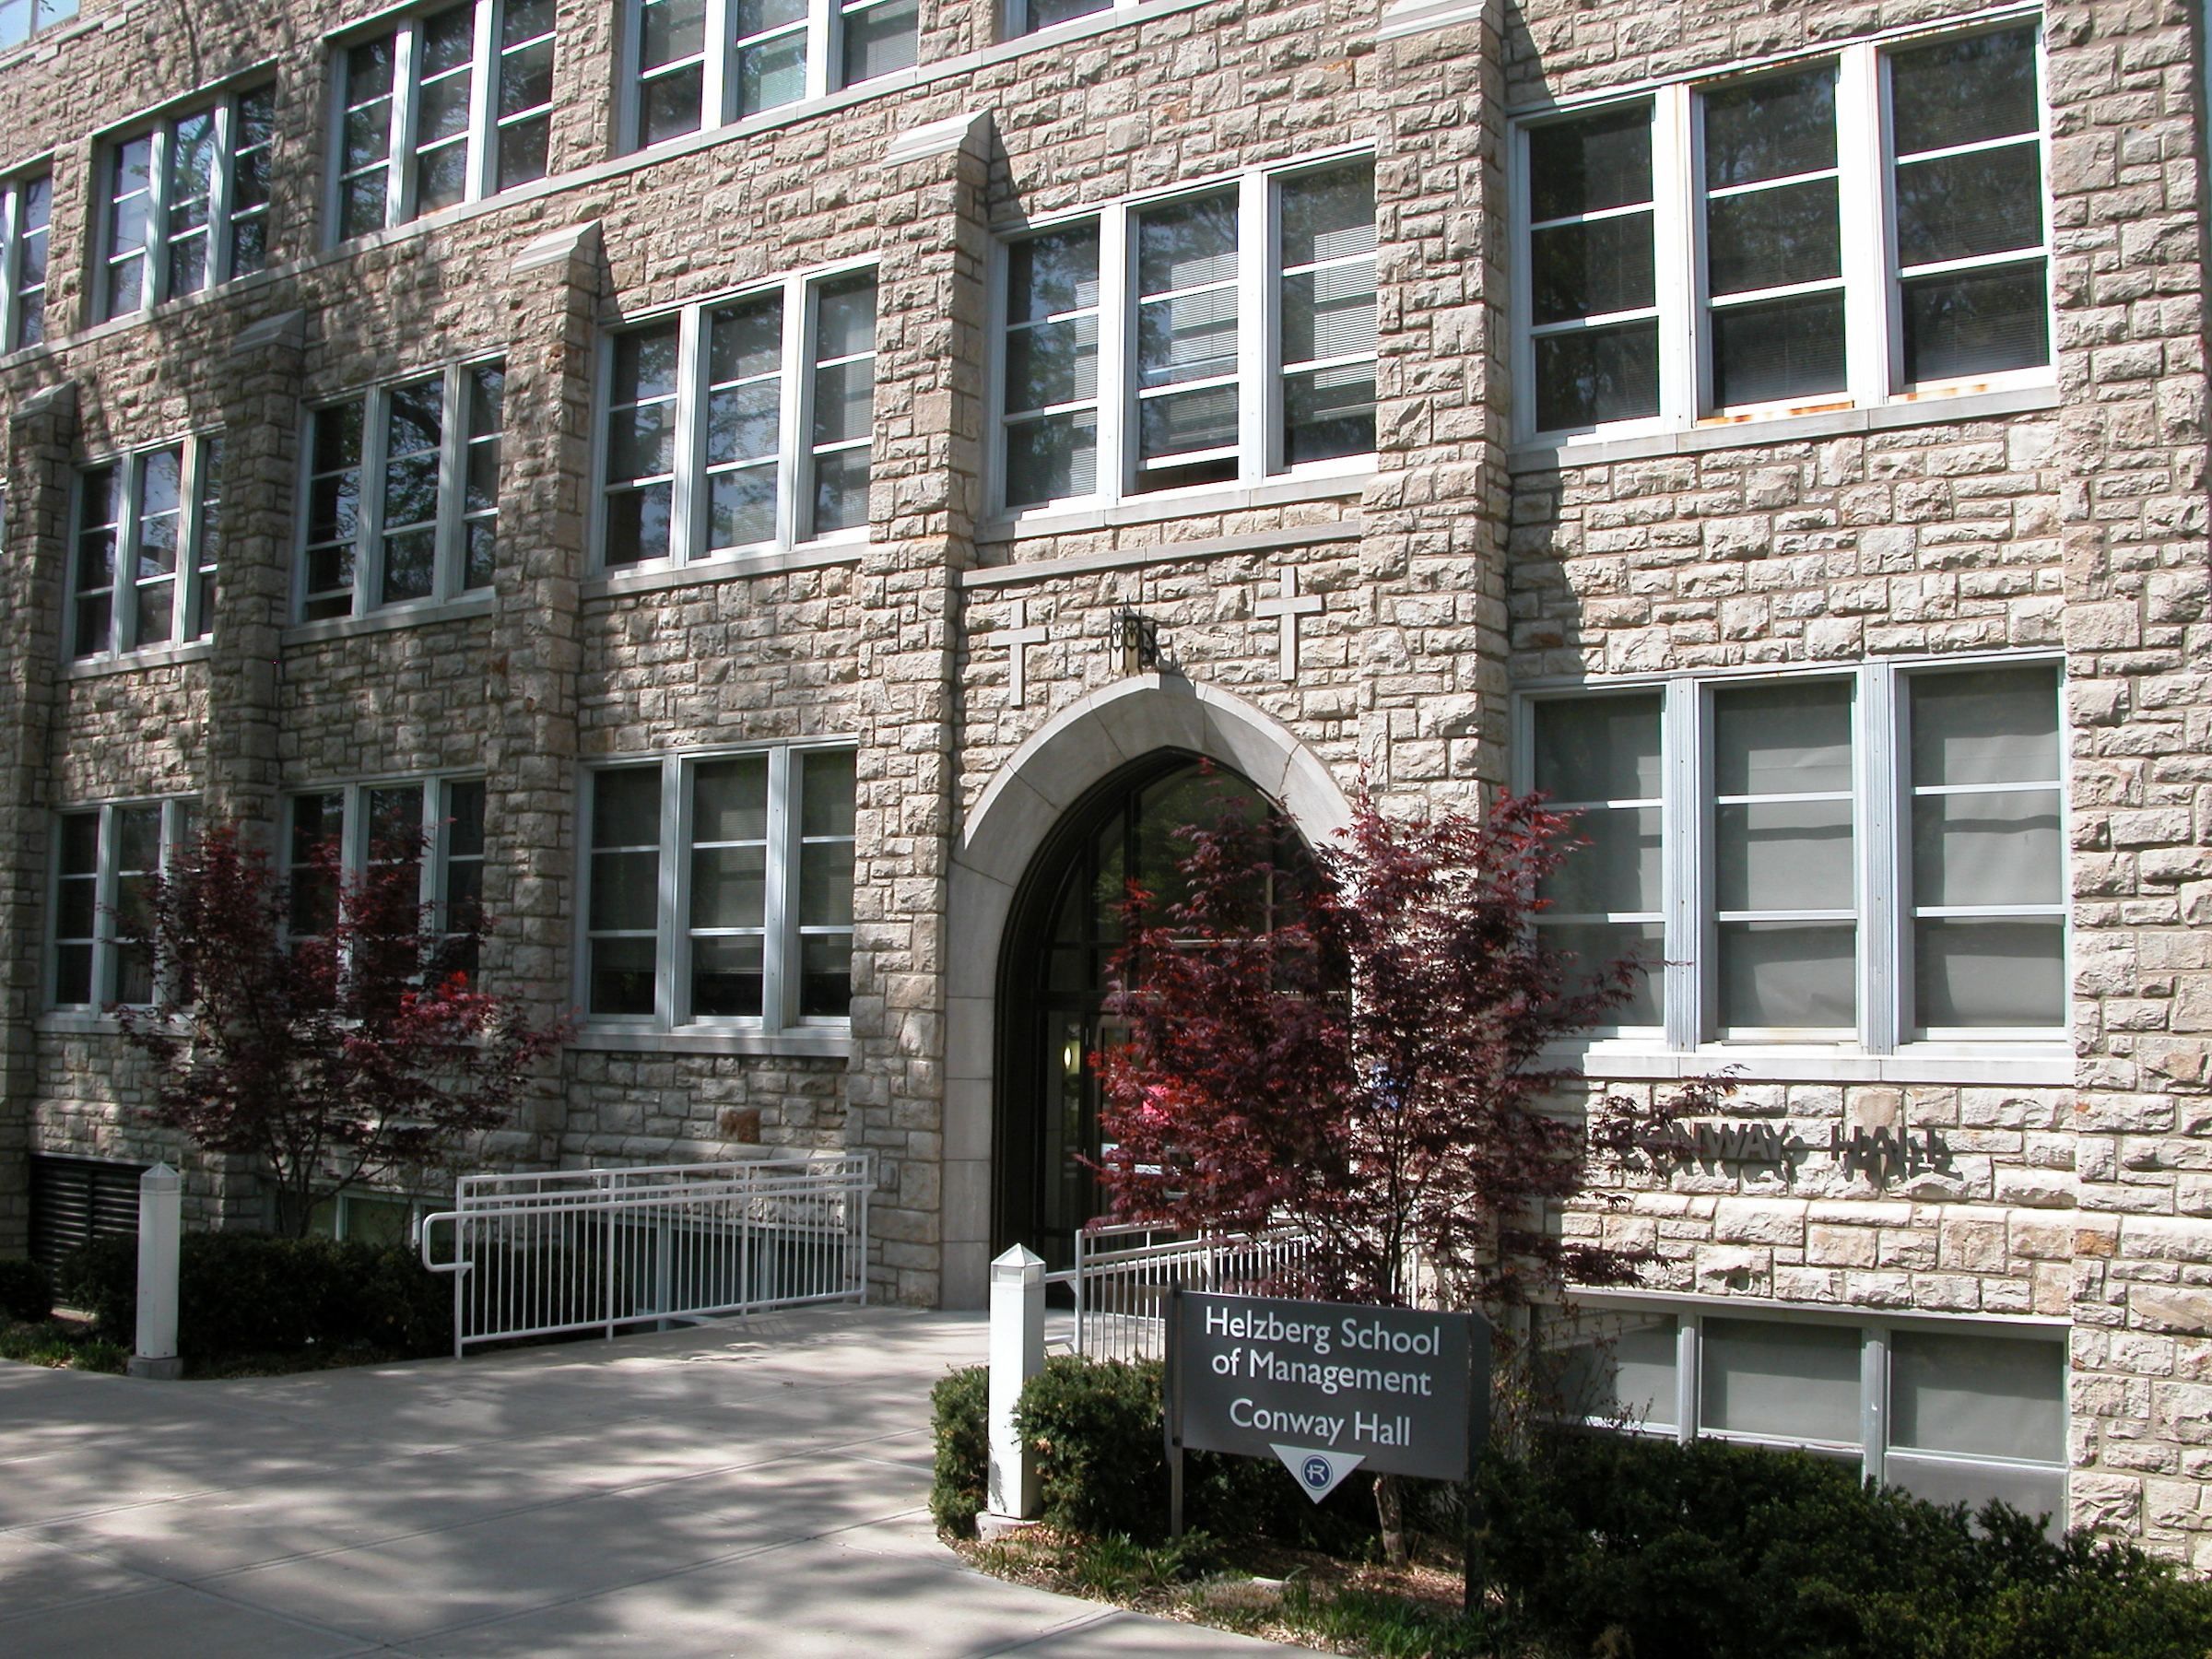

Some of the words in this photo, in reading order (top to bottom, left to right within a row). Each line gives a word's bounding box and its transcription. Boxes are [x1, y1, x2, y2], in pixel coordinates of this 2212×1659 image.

[1831, 1125, 1950, 1164] HALL
[1206, 1306, 1330, 1354] Helzberg
[1341, 1318, 1440, 1356] School
[1212, 1348, 1241, 1376] of
[1249, 1349, 1431, 1395] Management
[1230, 1398, 1345, 1446] Conway
[1355, 1411, 1410, 1446] Hall
